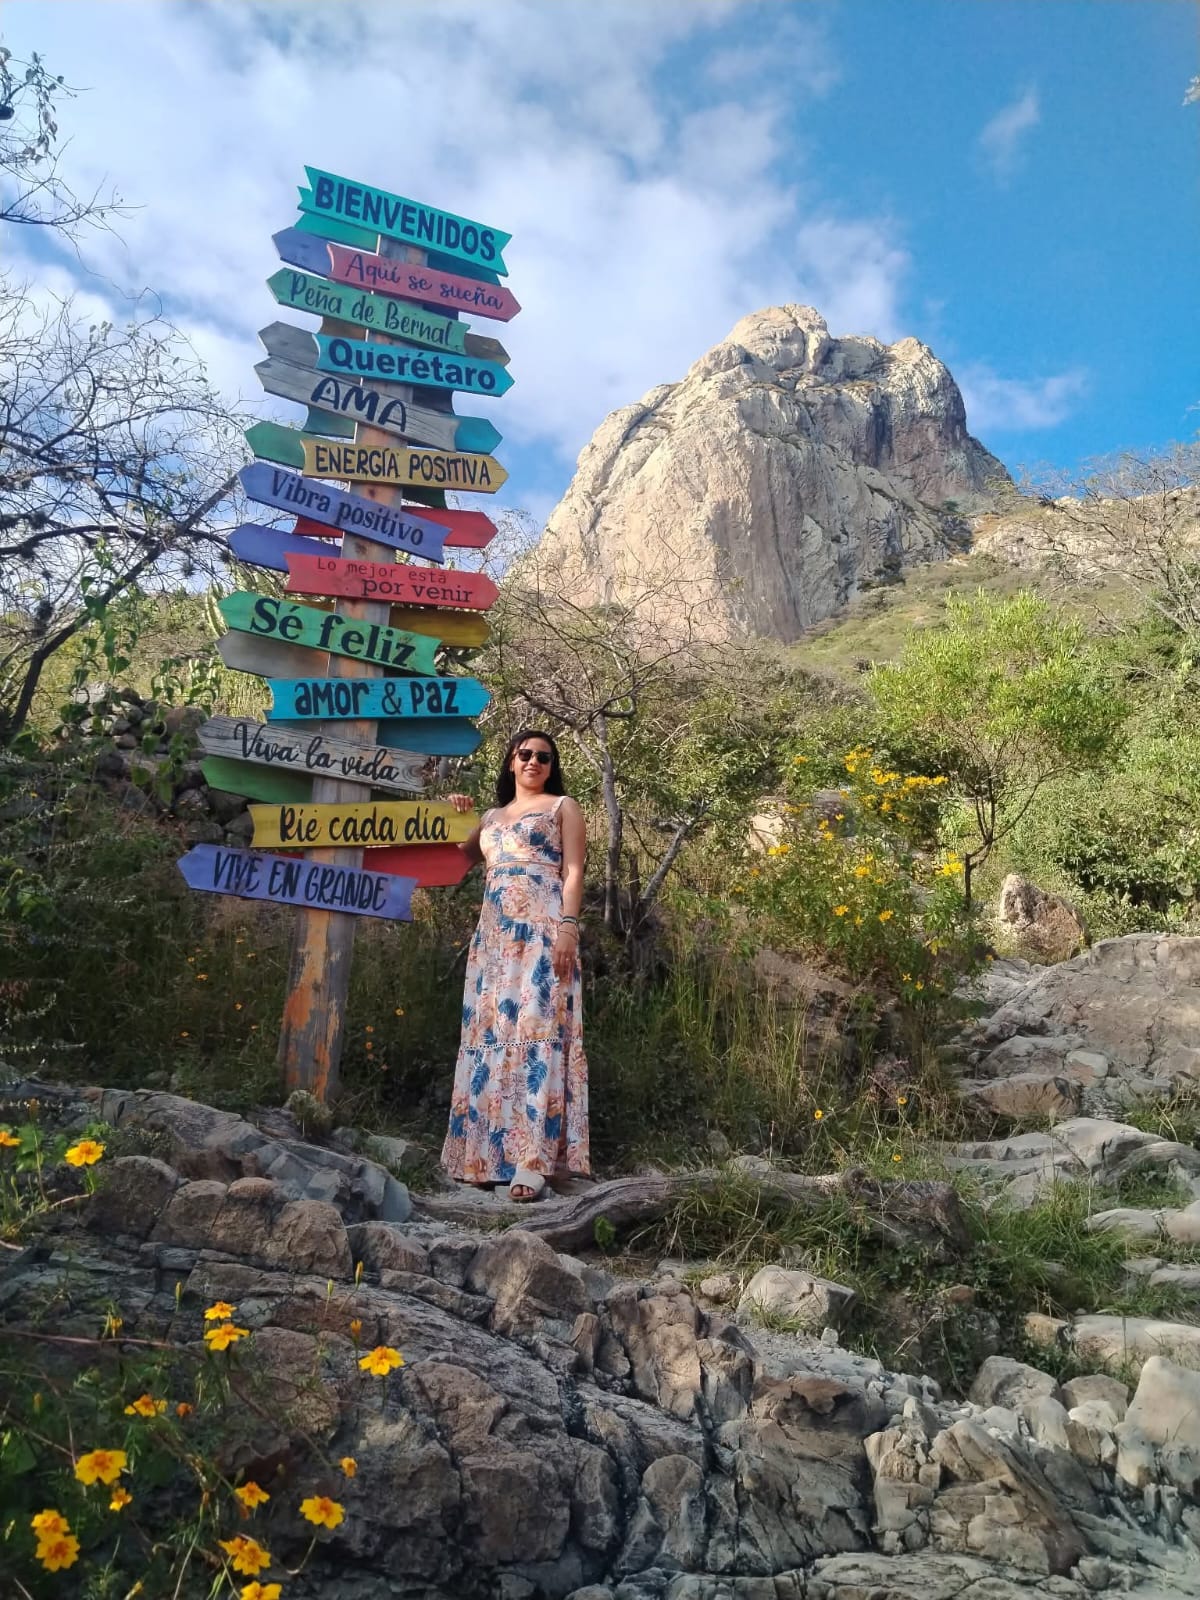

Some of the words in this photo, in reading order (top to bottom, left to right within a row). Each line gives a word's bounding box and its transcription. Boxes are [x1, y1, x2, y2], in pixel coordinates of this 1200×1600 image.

[315, 176, 495, 261] BIENVENIDOS
[289, 273, 342, 314] Peña
[384, 302, 455, 346] Bernal
[345, 254, 401, 284] Aquí
[409, 274, 432, 291] se
[440, 282, 503, 310] sueña
[329, 339, 496, 390] Querétaro
[310, 377, 407, 432] AMA
[315, 445, 399, 478] ENERGÍA
[408, 453, 491, 486] POSITIVA
[271, 470, 331, 512] Vibra
[334, 500, 424, 546] positivo
[317, 557, 337, 572] Lo
[349, 563, 397, 579] mejor
[408, 571, 447, 584] está
[362, 578, 402, 597] por
[413, 584, 474, 602] venir
[250, 597, 303, 641] Sé
[316, 614, 416, 668] feliz
[381, 682, 402, 715] &
[233, 723, 300, 763] Viva
[304, 736, 335, 768] la
[340, 748, 400, 781] vida
[328, 807, 398, 842] cada
[213, 852, 263, 893] VIVE
[268, 861, 300, 897] EN
[304, 866, 389, 911] GRANDE
